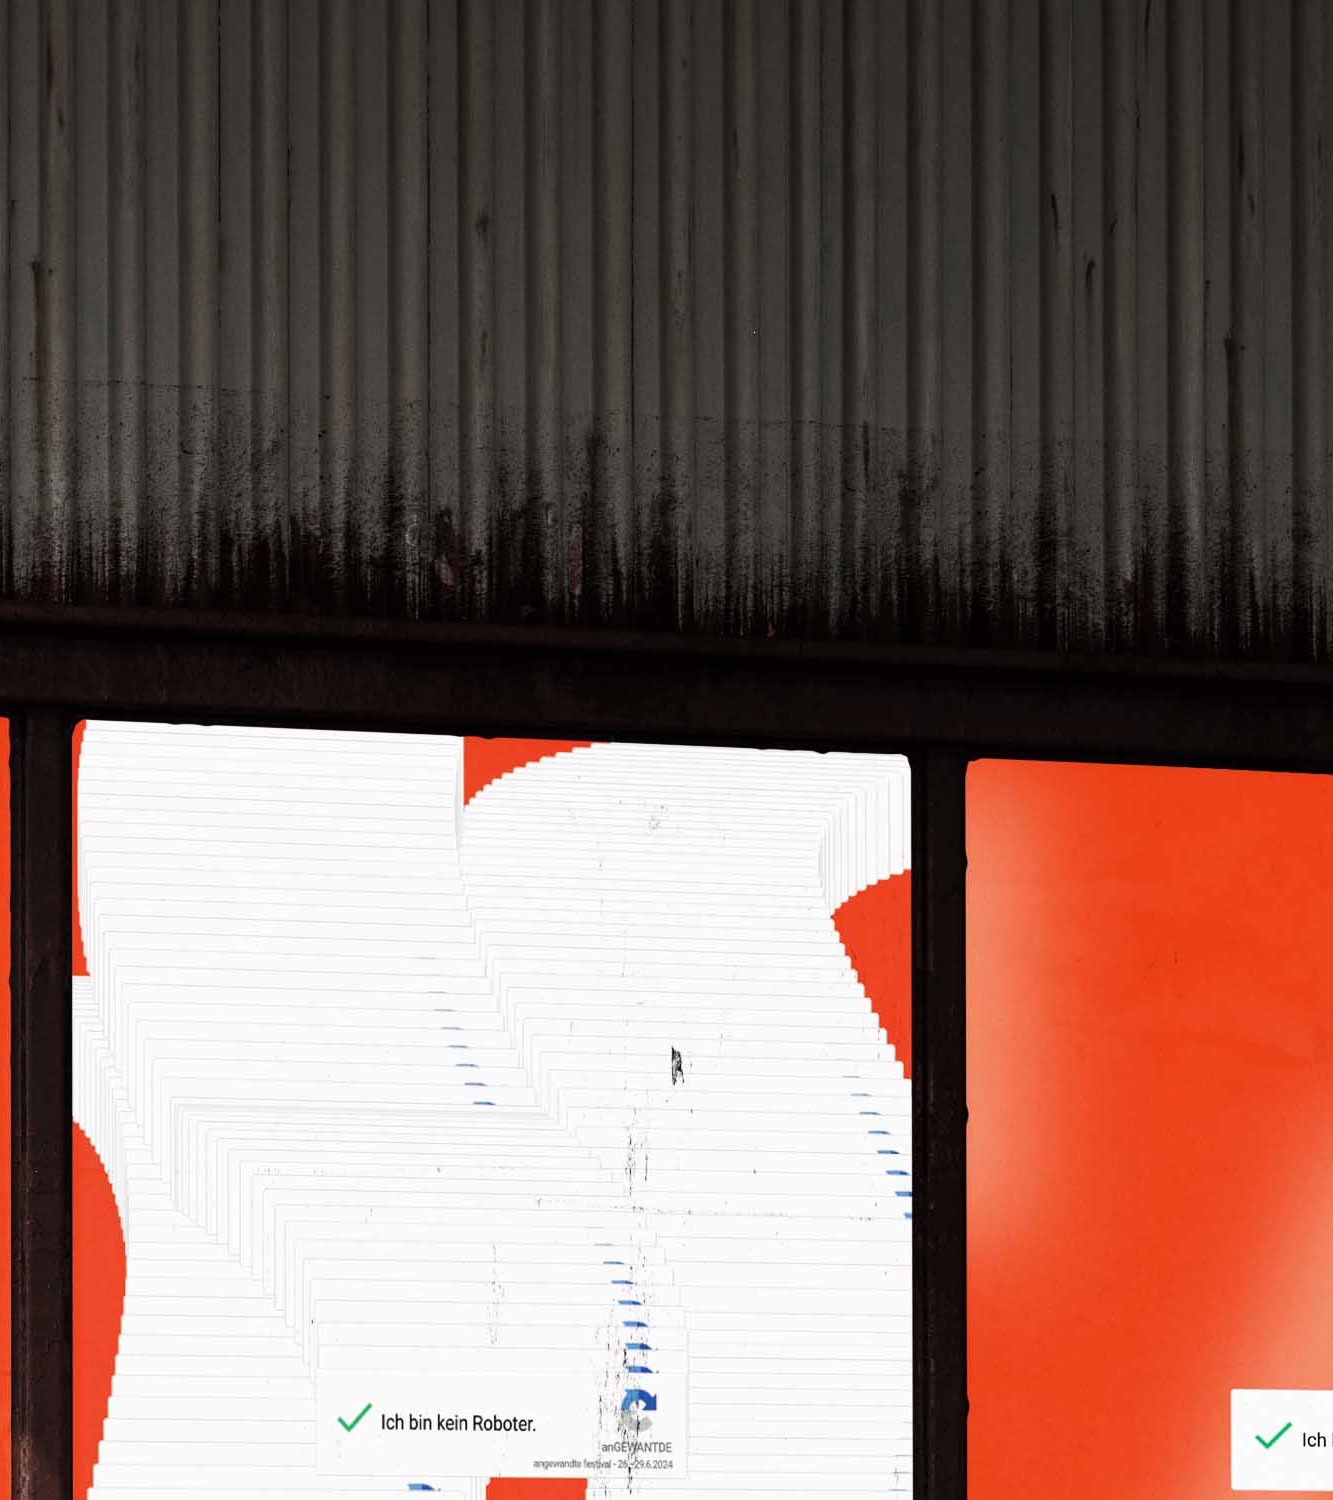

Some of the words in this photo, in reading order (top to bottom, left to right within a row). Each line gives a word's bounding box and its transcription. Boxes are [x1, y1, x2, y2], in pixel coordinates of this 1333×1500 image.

[381, 1414, 405, 1431] Ich
[409, 1414, 433, 1431] bin
[437, 1414, 468, 1431] kein
[472, 1415, 536, 1432] Roboter.
[1302, 1432, 1327, 1448] Ich
[601, 1441, 672, 1455] anGEWANTDE
[533, 1460, 582, 1471] angewandte
[583, 1459, 612, 1470] festival
